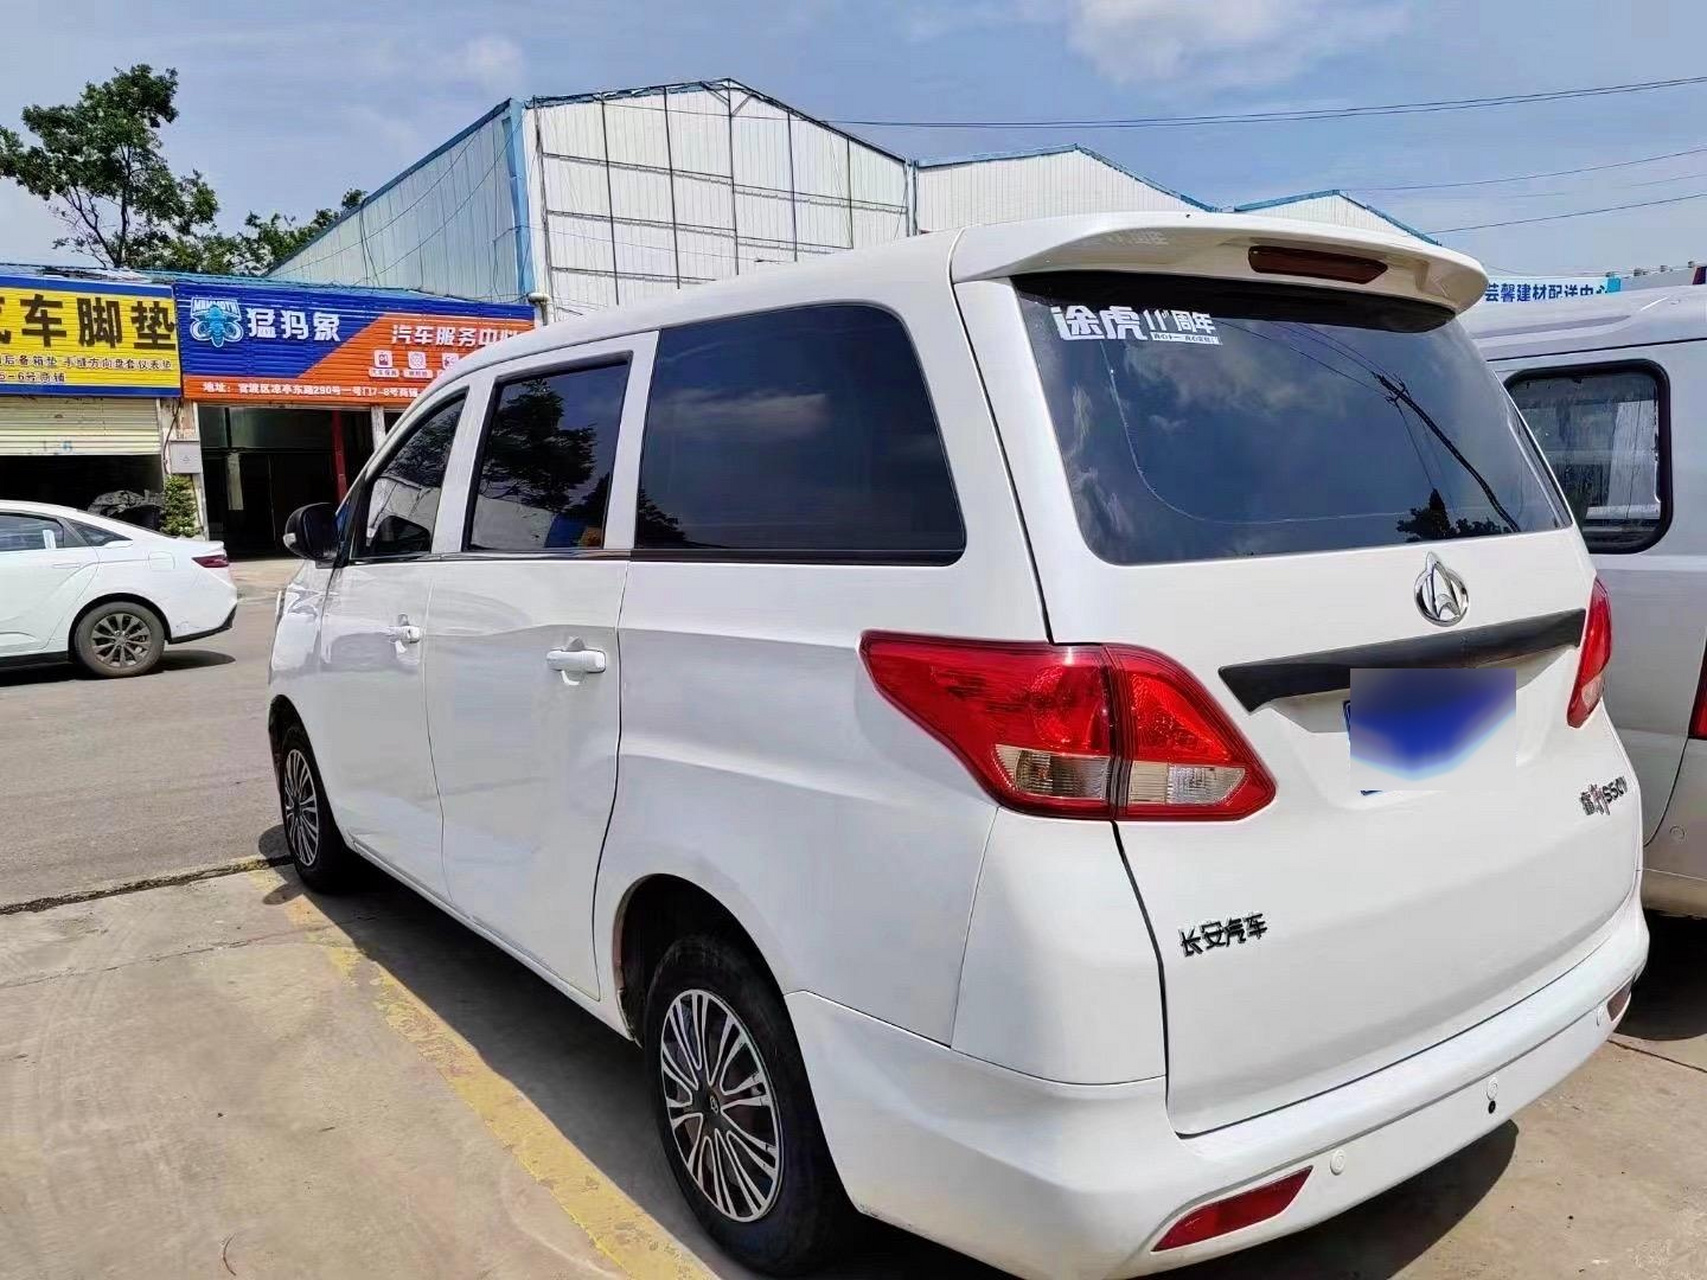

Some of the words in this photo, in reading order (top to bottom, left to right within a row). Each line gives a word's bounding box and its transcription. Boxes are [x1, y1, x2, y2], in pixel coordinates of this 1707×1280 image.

[0, 354, 58, 367] 后备箱垫
[1179, 913, 1268, 957] 长安汽车
